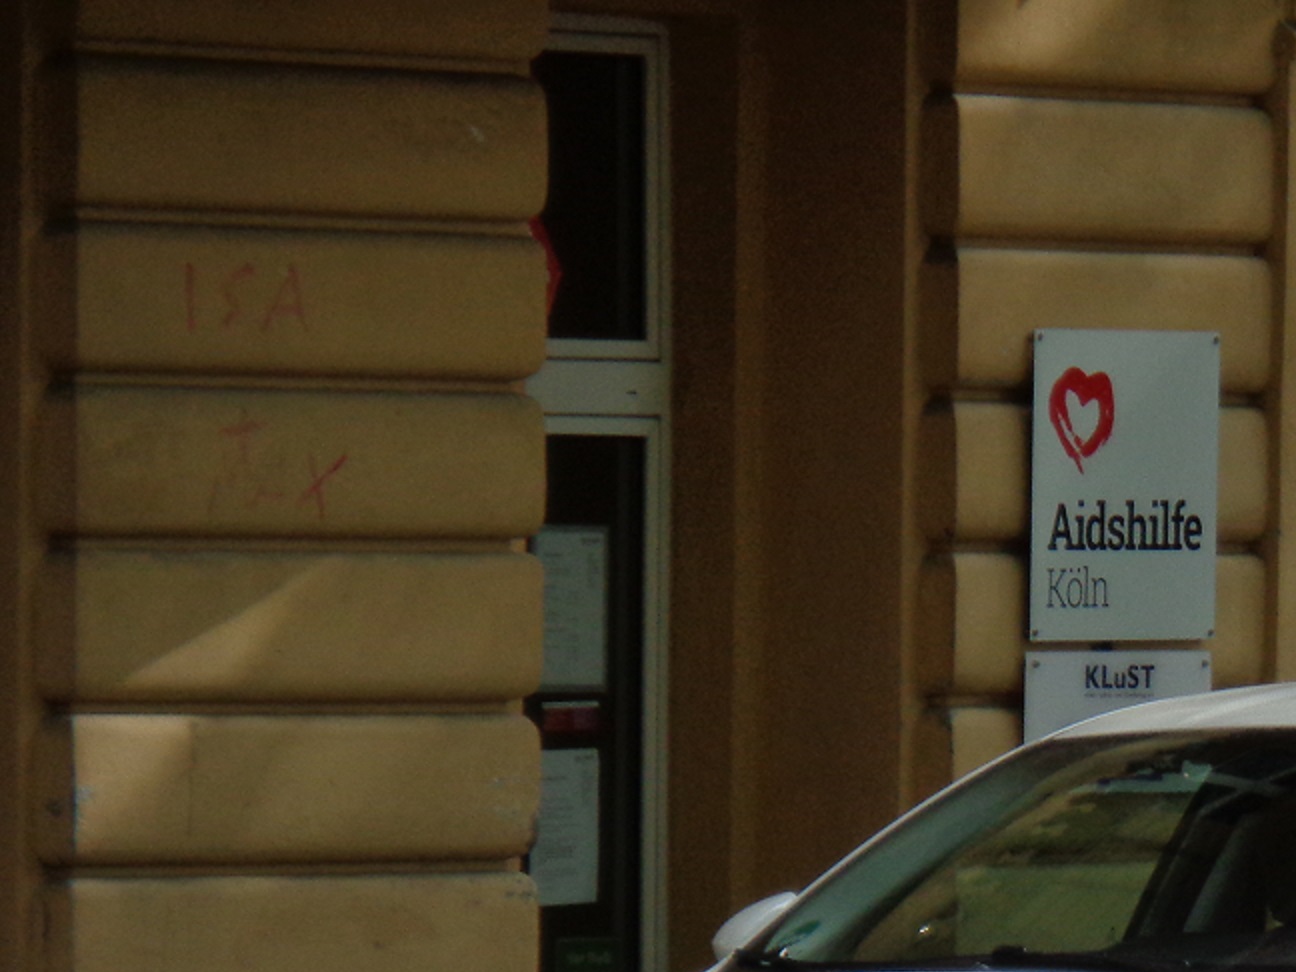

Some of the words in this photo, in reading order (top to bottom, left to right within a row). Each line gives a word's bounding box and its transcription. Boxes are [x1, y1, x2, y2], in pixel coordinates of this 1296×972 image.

[1047, 500, 1203, 552] Aidshilfe
[1046, 567, 1109, 609] Köln
[1085, 664, 1155, 689] KLuST
